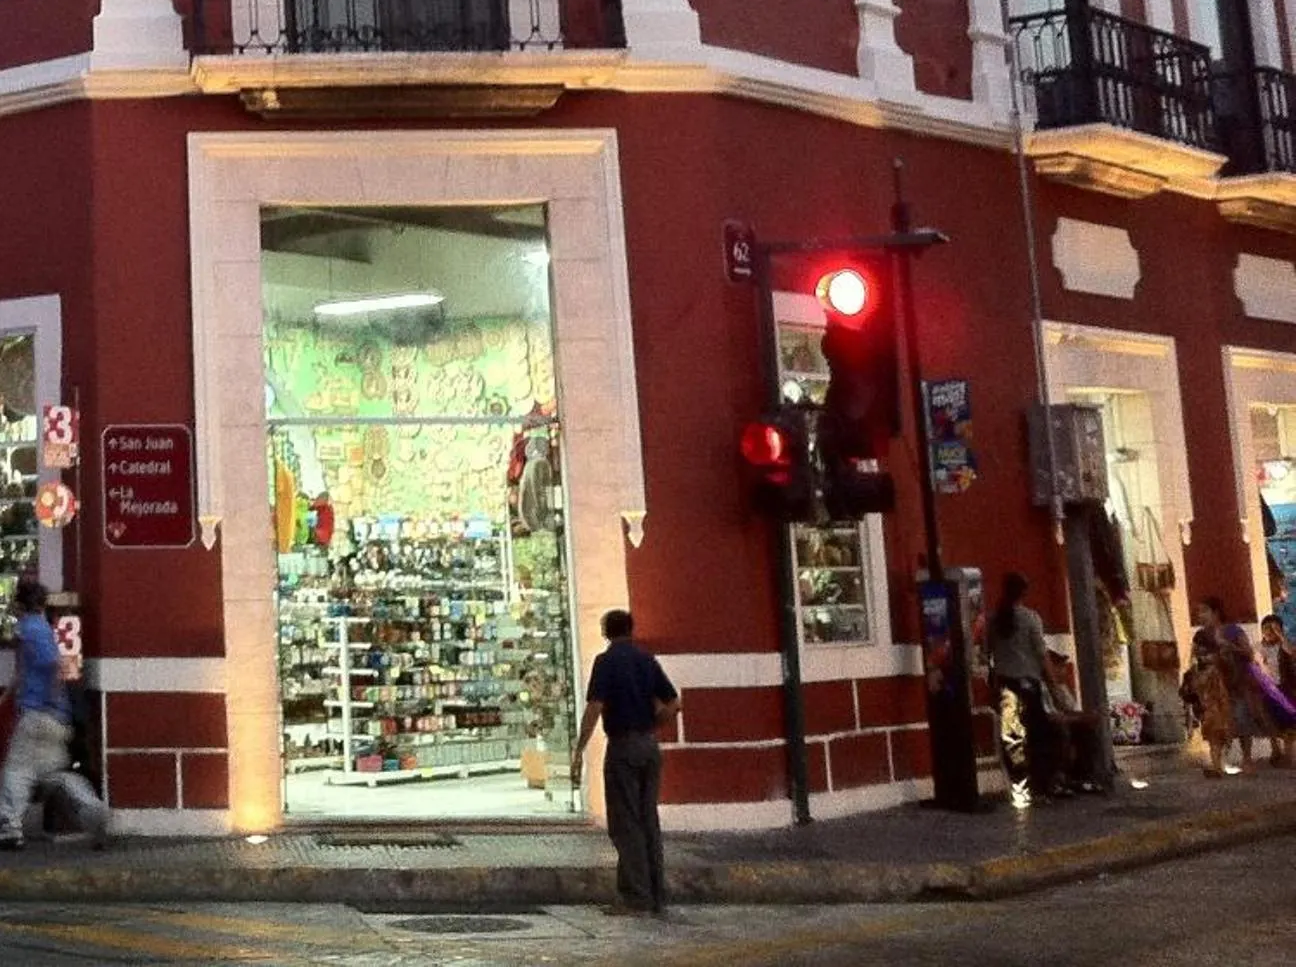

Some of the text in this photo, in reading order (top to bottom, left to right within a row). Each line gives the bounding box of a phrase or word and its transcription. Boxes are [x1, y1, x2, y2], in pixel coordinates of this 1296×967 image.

[733, 241, 751, 262] 62
[119, 435, 174, 451] San Juan
[119, 459, 172, 475] Catedral
[120, 485, 134, 500] La
[120, 500, 179, 517] Mejorada
